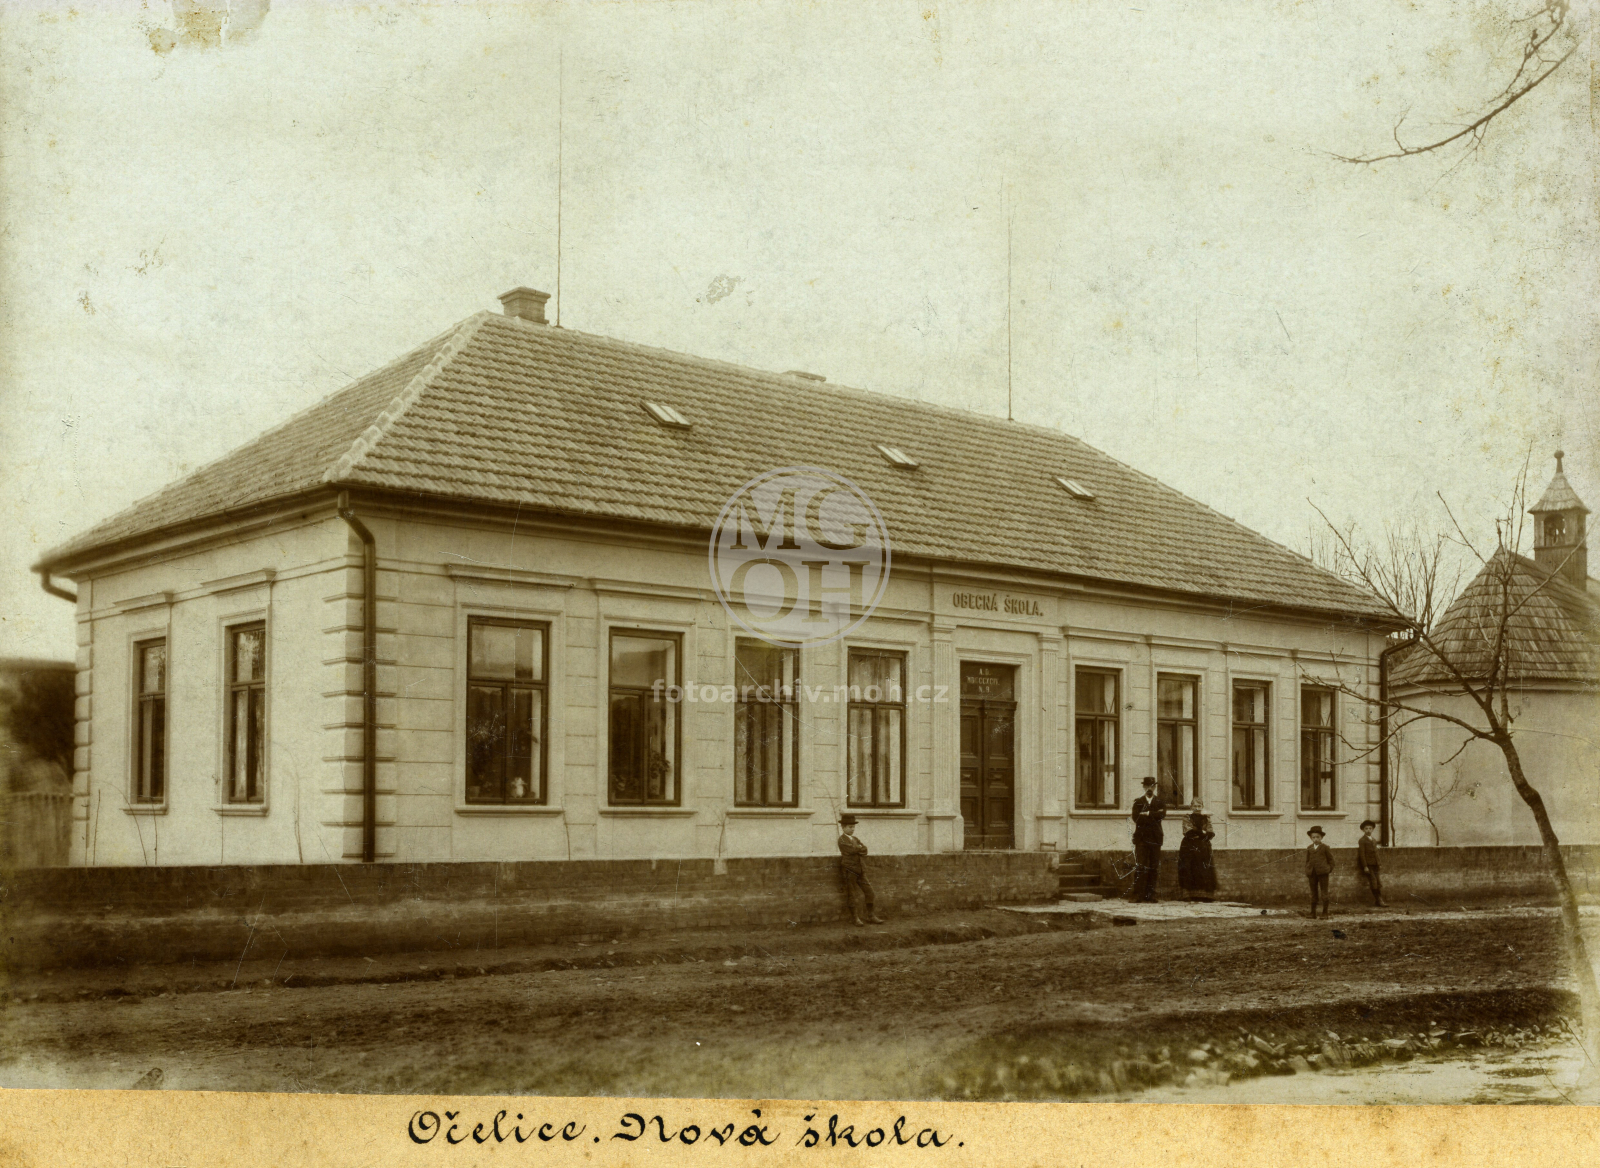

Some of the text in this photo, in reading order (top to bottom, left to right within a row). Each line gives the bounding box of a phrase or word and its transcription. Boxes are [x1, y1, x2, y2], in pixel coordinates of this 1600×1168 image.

[953, 592, 1044, 617] OBECNÁ ŠKOLA.
[407, 1109, 600, 1145] Očelice.
[796, 1113, 964, 1148] škola.
